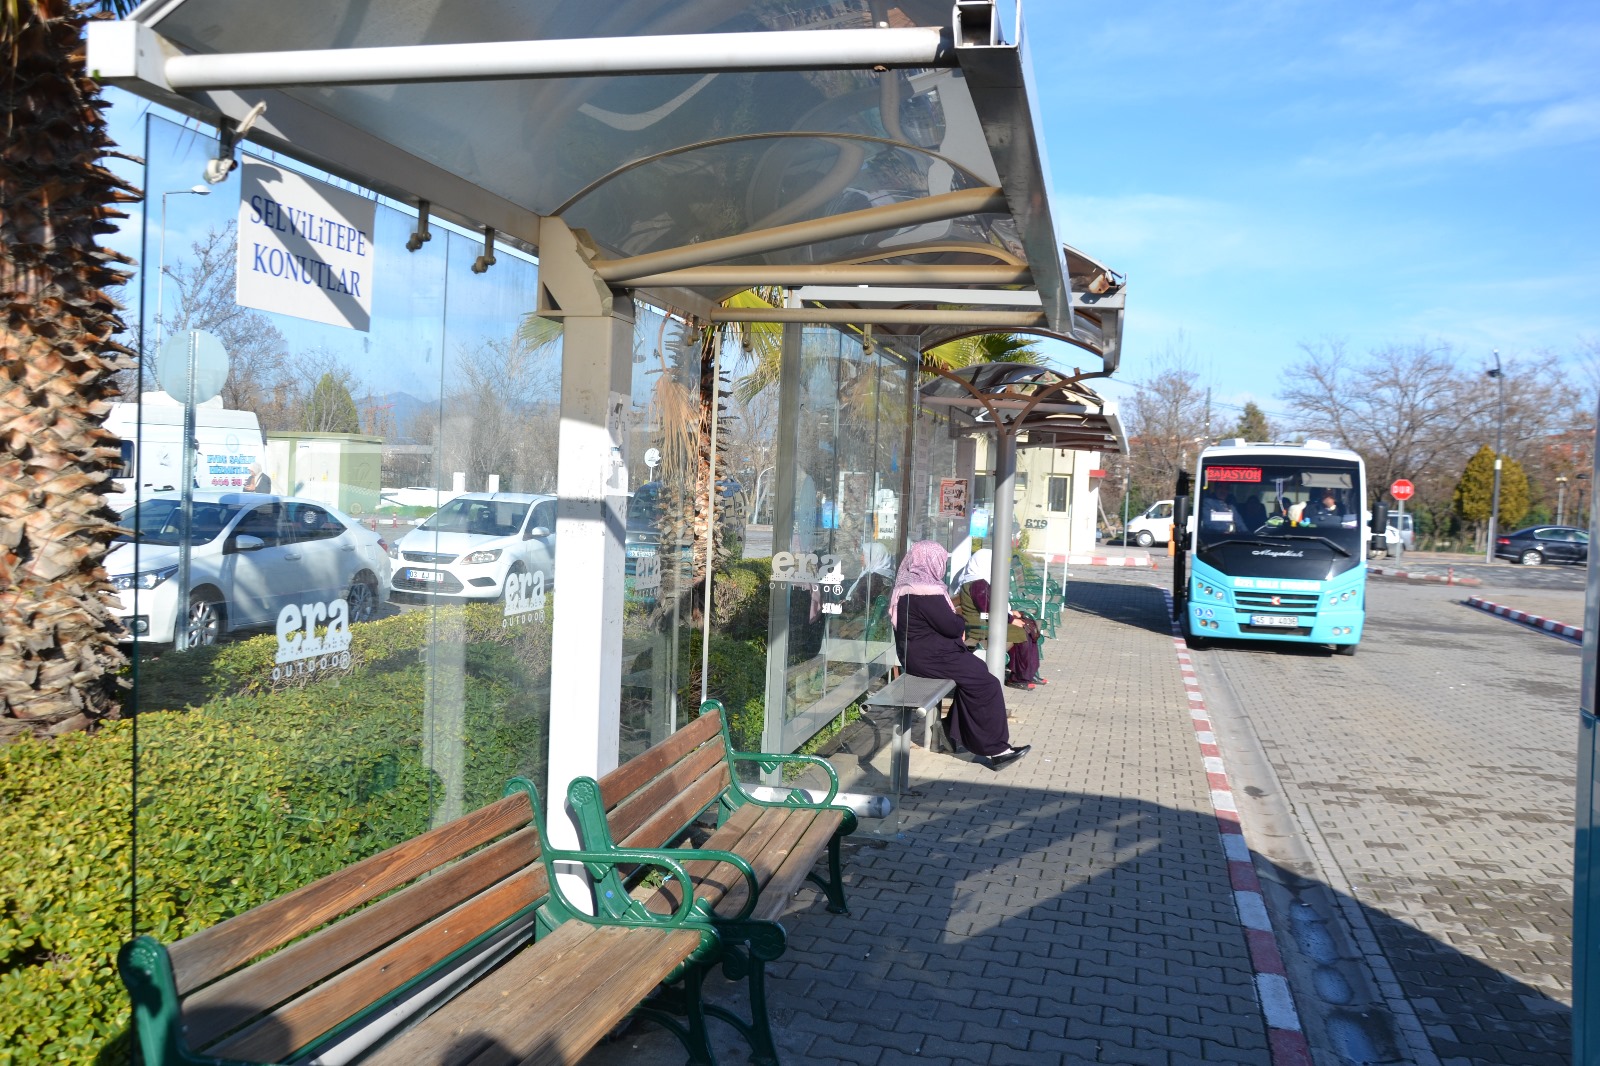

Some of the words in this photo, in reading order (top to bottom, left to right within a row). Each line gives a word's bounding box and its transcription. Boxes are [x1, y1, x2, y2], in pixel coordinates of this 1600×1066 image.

[252, 242, 361, 298] KONUTLAR
[1393, 485, 1411, 494] DUR
[771, 551, 844, 584] era
[504, 570, 546, 616] era
[275, 598, 353, 664] era
